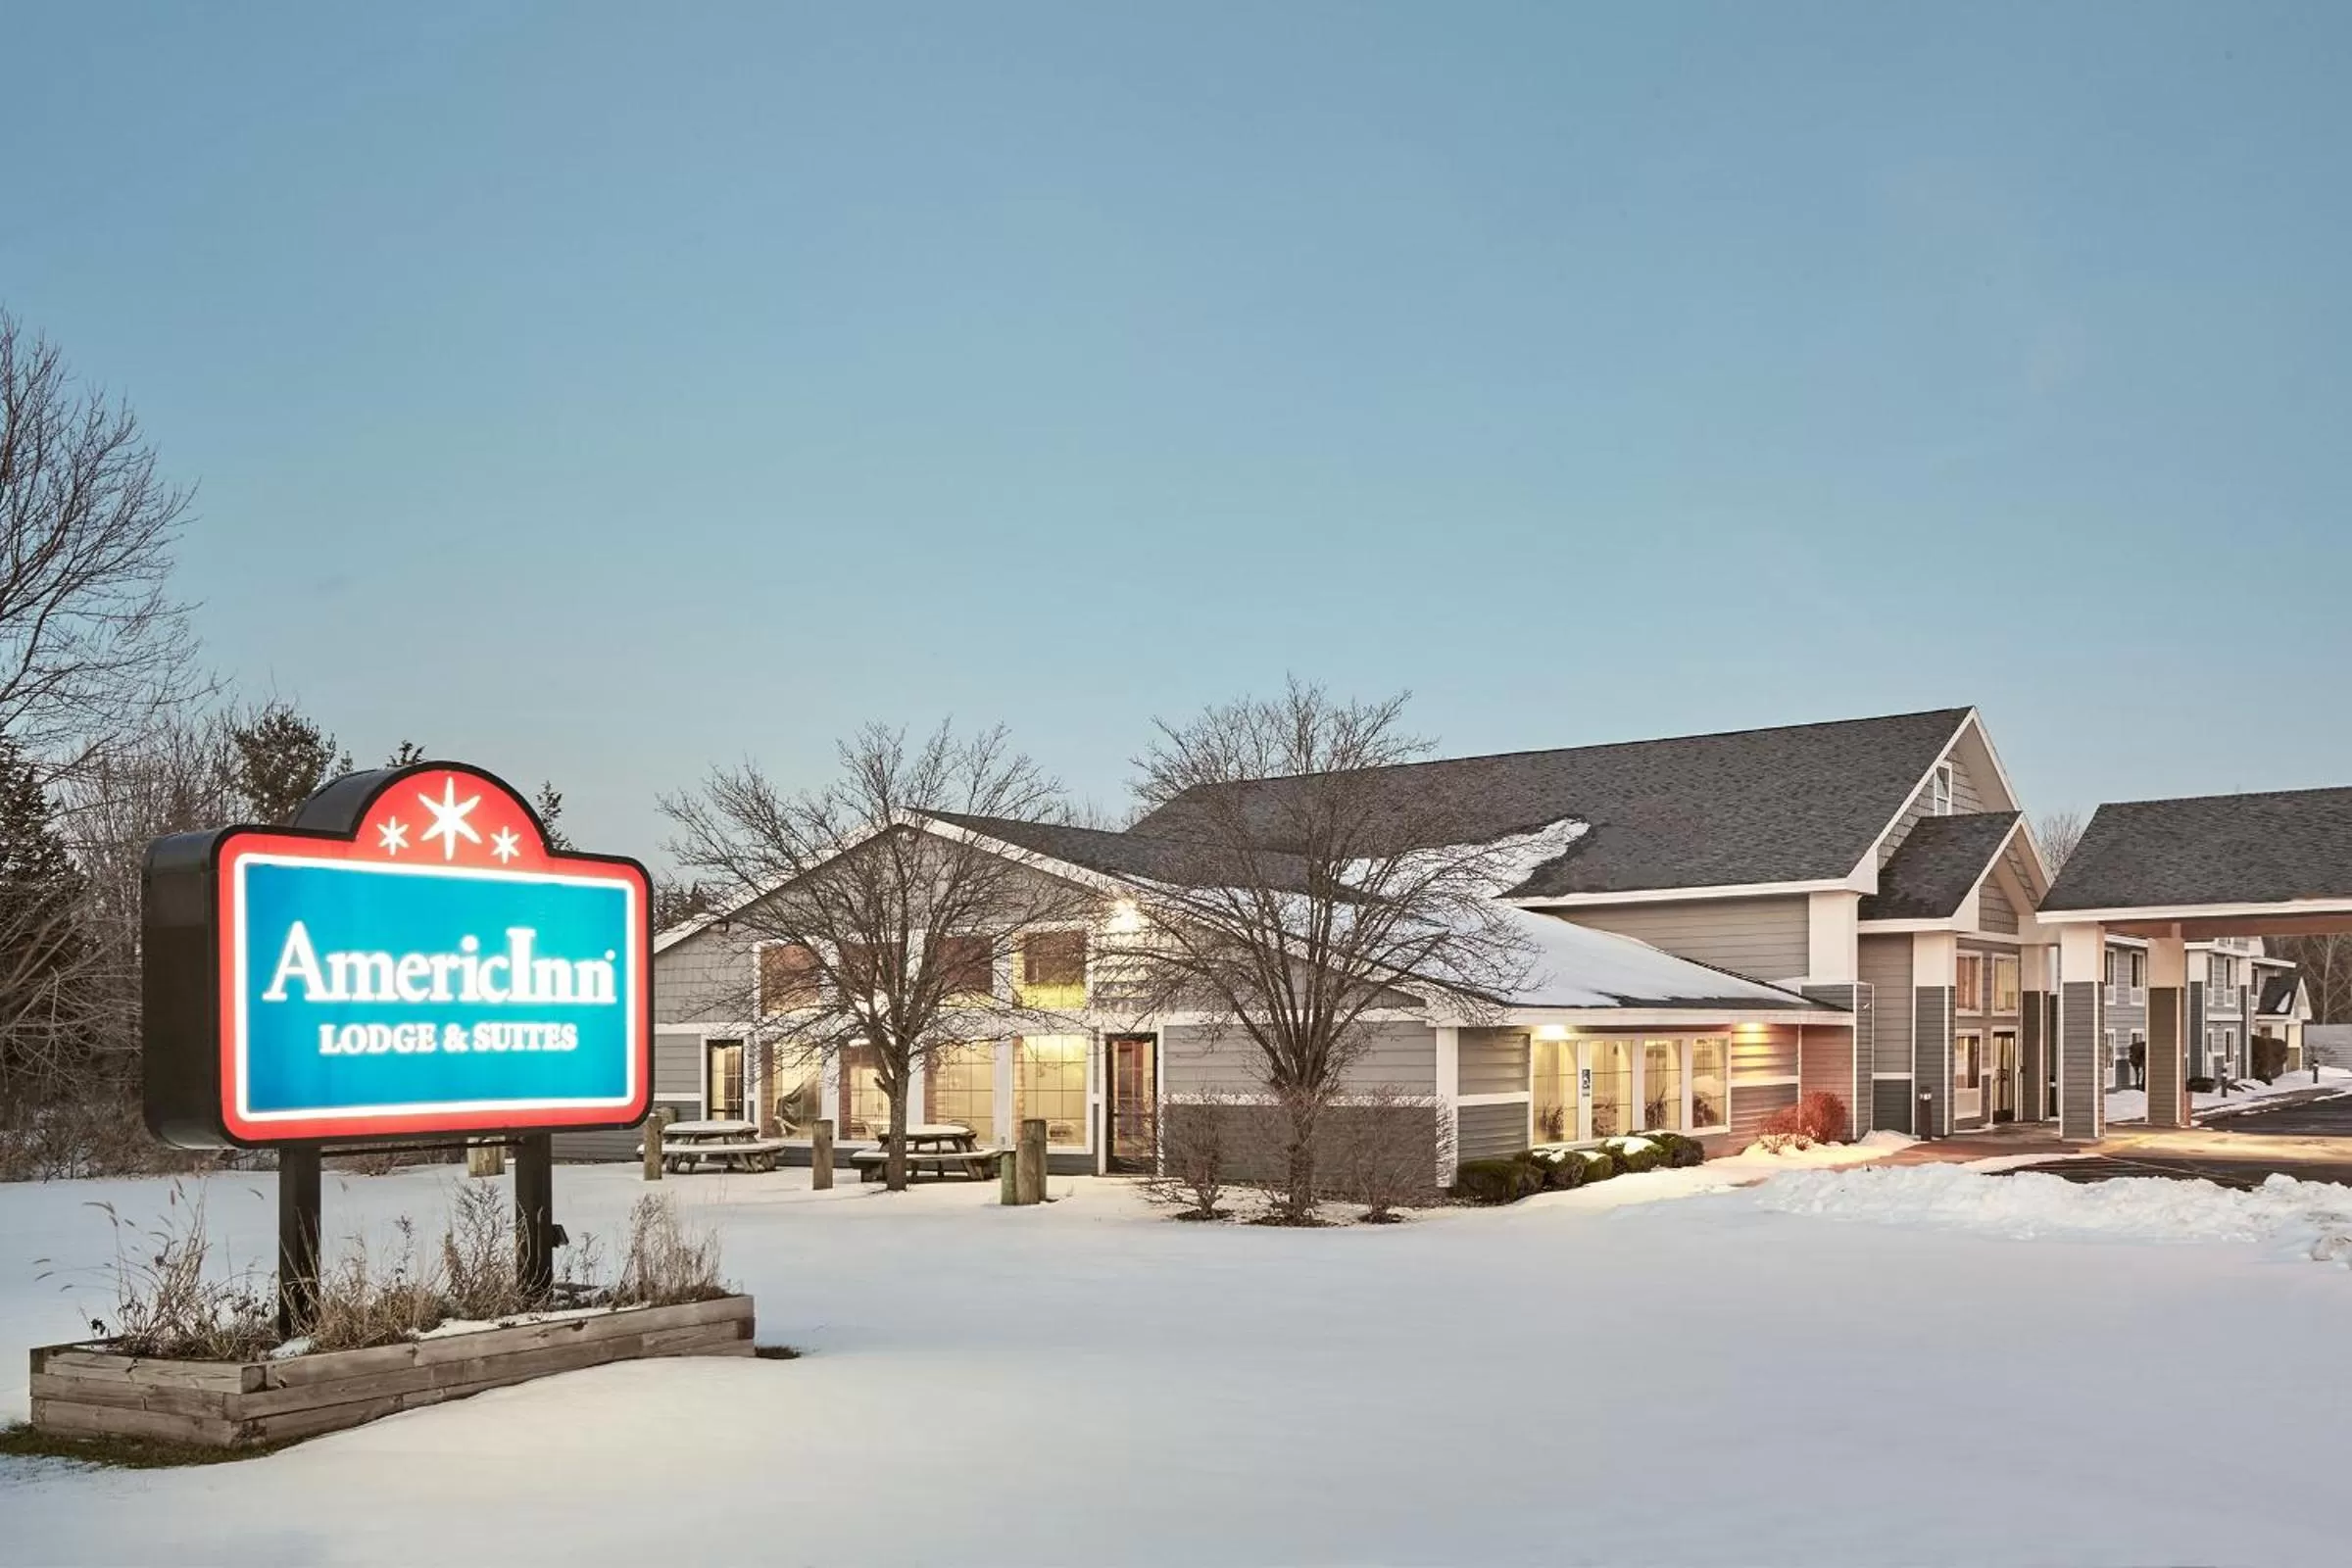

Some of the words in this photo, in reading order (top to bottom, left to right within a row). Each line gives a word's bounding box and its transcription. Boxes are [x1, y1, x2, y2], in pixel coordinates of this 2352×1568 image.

[262, 919, 617, 1004] AmericInn
[318, 1022, 438, 1055] LODGE
[443, 1023, 469, 1053] &
[472, 1021, 578, 1052] SUITES
